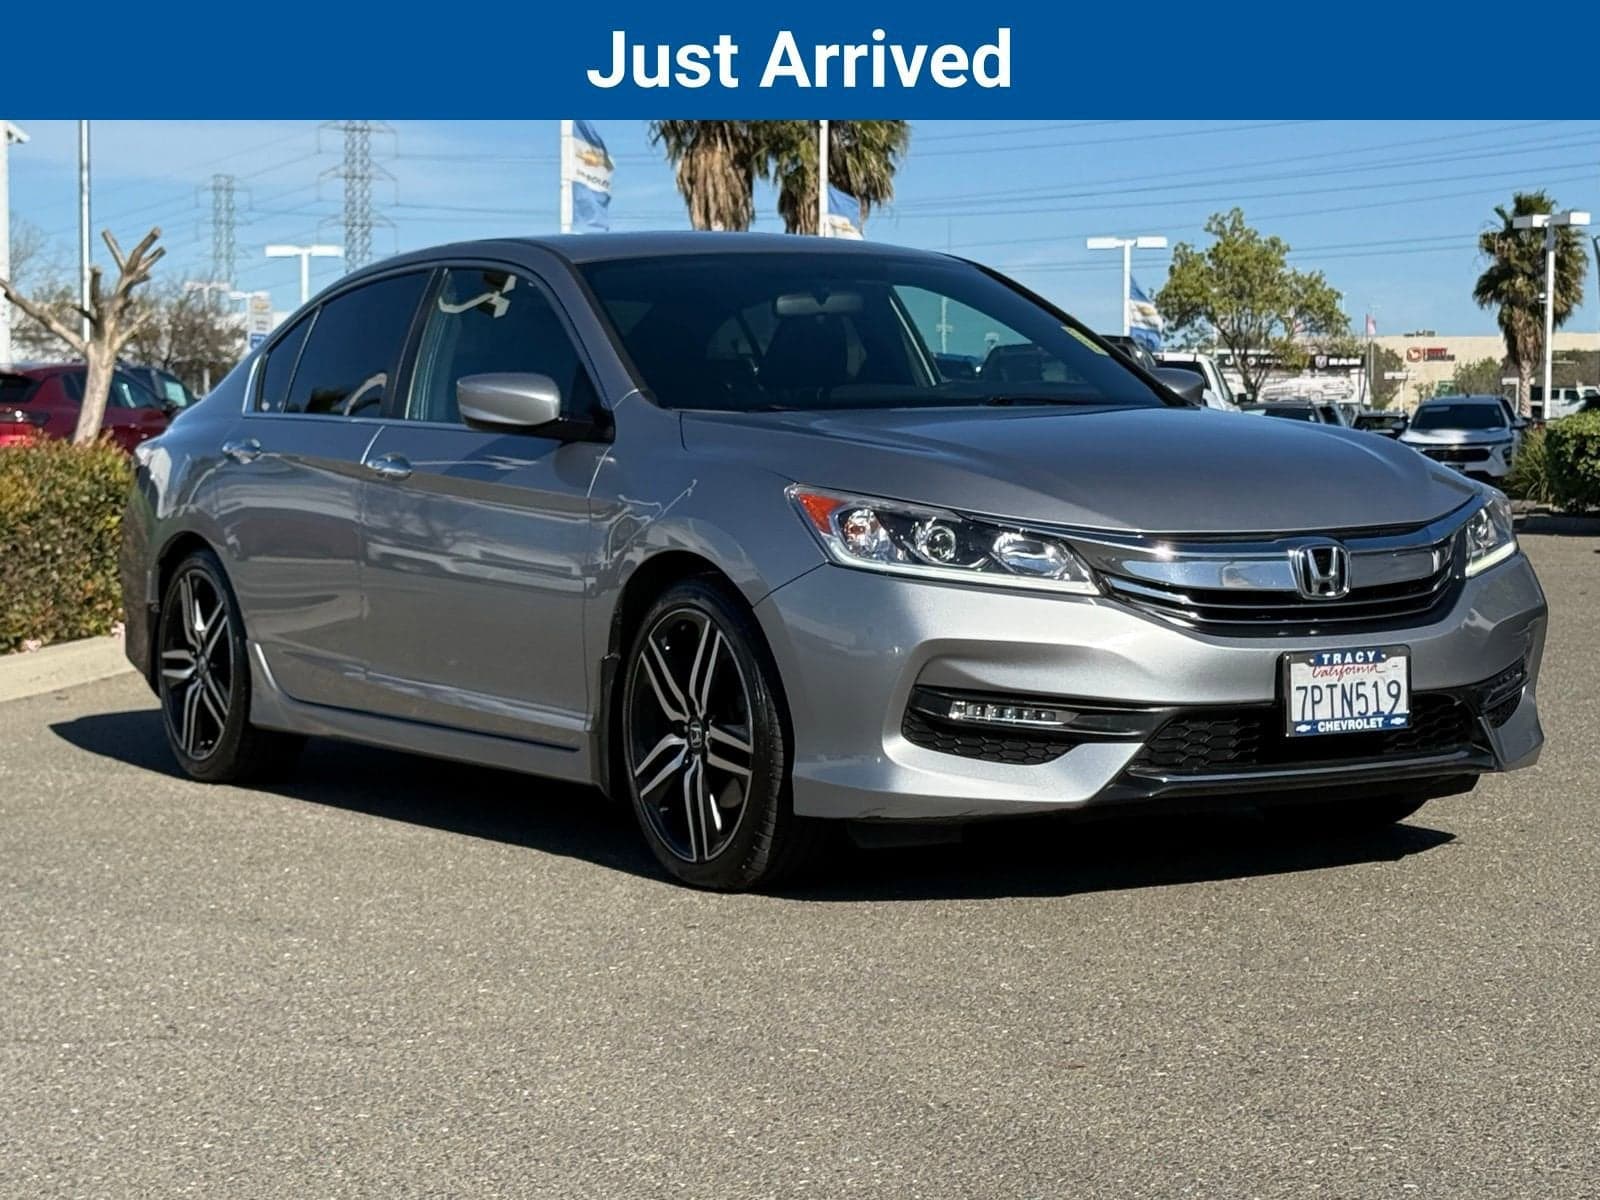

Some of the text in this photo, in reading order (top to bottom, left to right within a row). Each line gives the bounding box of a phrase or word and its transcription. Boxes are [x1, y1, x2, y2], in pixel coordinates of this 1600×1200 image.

[1329, 357, 1362, 366] RAM
[1322, 650, 1376, 664] TRACY
[1312, 664, 1385, 682] California
[1296, 679, 1402, 720] 7PTN519
[1317, 717, 1385, 732] CHEVROLET
